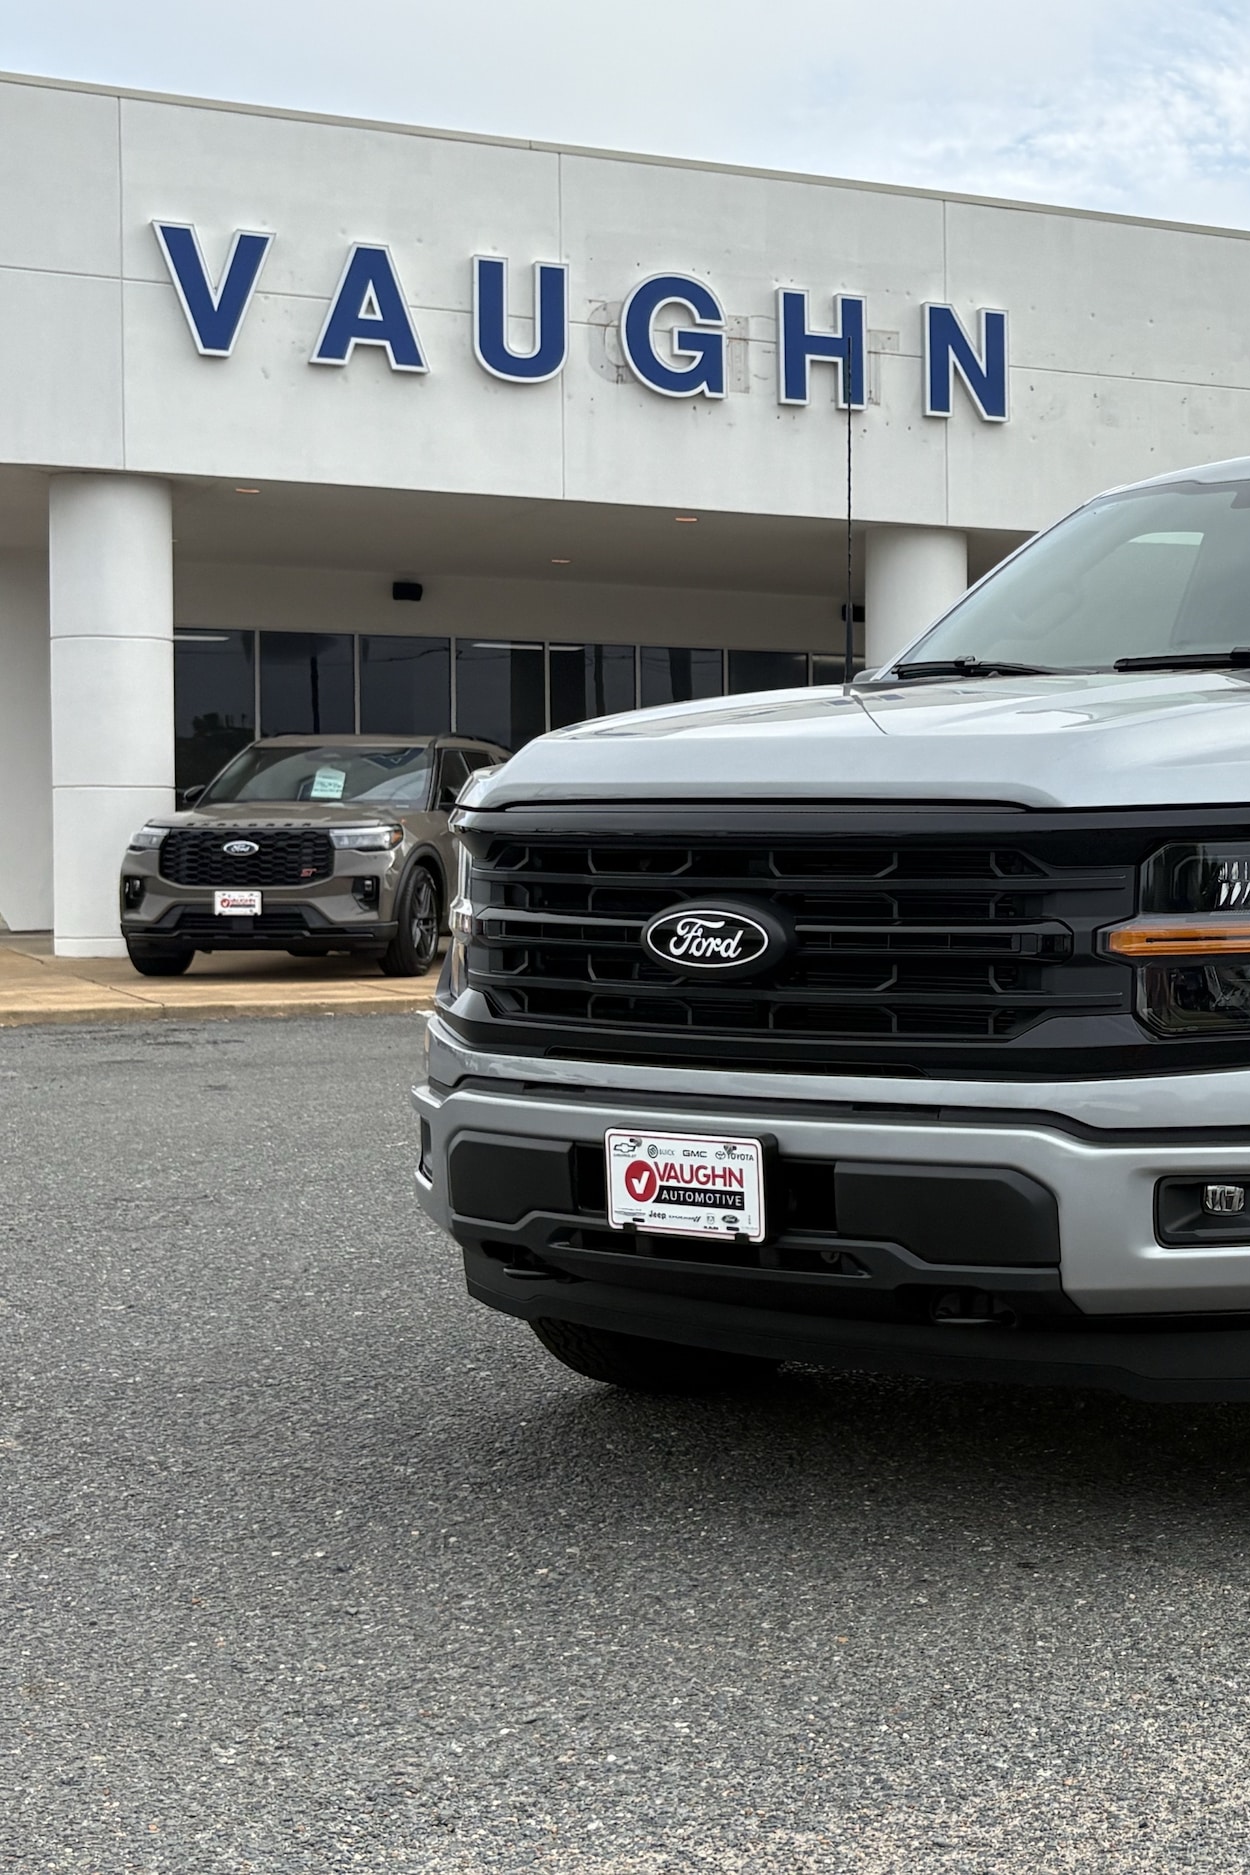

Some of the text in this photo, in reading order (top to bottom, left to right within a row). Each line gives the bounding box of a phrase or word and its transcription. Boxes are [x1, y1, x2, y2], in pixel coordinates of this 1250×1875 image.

[151, 219, 1009, 422] VAUGHN
[669, 917, 745, 959] Ford
[682, 1149, 707, 1159] GMC
[726, 1152, 754, 1162] TOYOTA
[653, 1161, 744, 1189] VAUGHN
[661, 1190, 743, 1207] AUTOMOTIVE
[649, 1210, 667, 1220] Jeep
